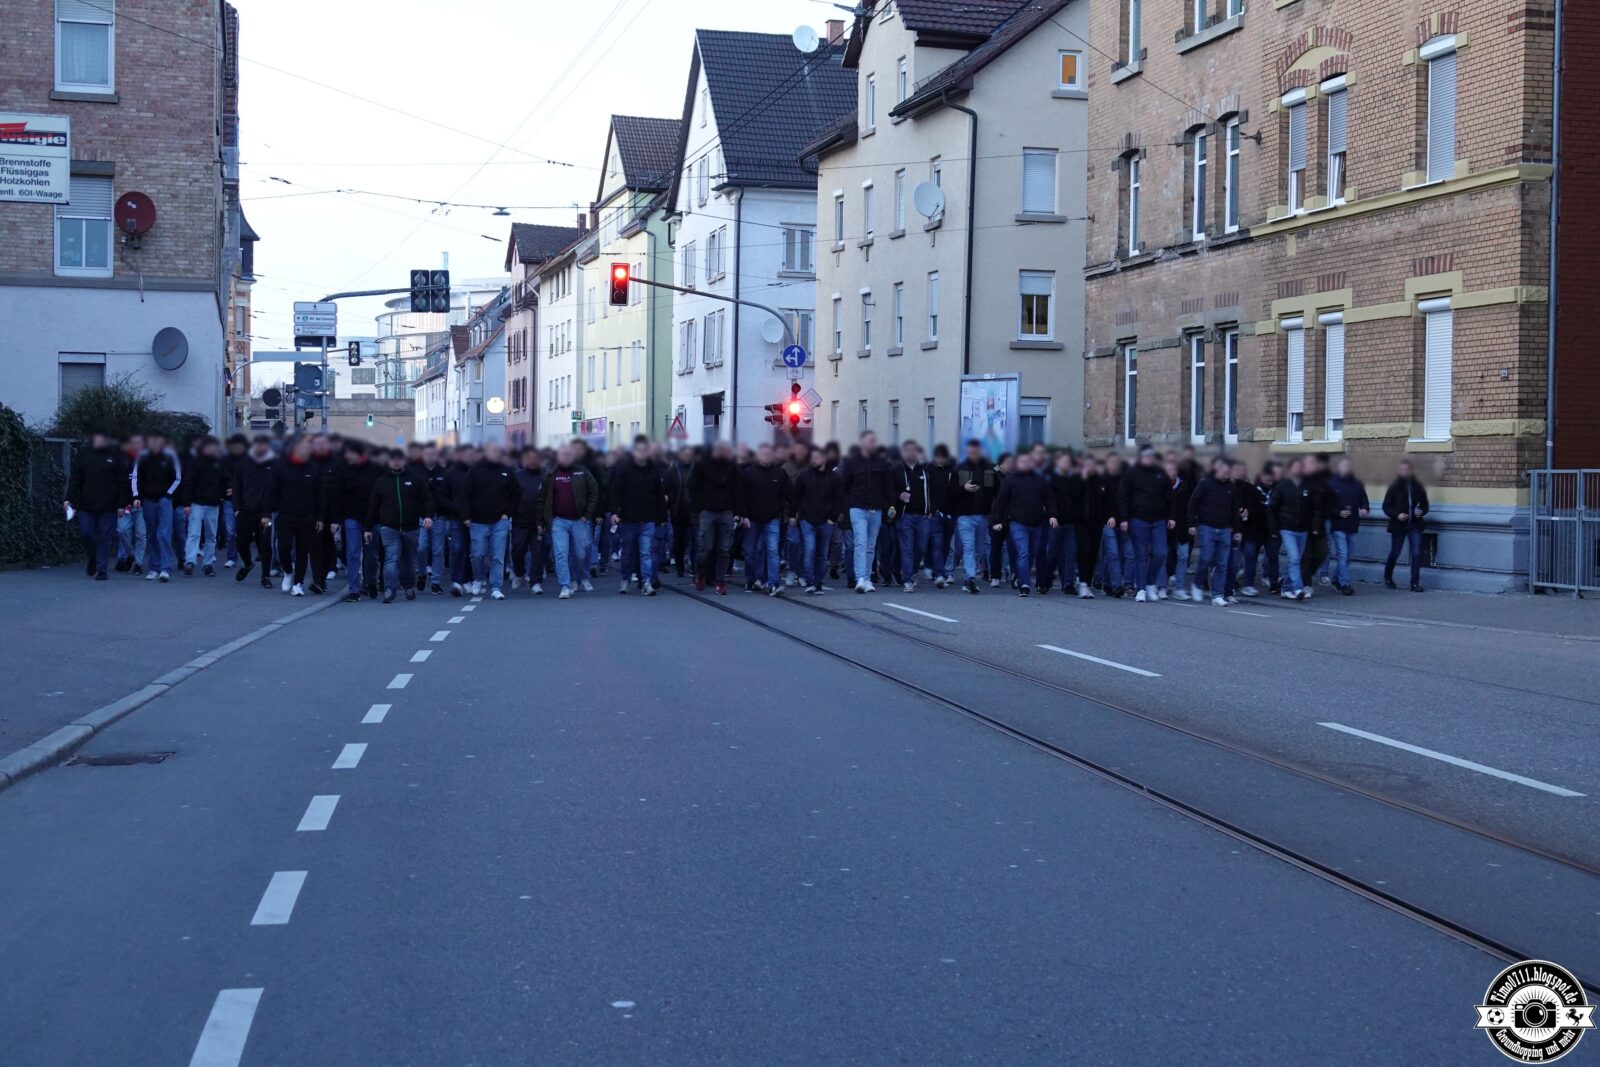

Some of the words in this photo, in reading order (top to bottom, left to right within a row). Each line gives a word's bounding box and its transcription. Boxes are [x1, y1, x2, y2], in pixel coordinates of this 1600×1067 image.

[0, 157, 51, 168] Brennstoffe
[1, 167, 49, 178] Flüssiggas
[0, 177, 50, 186] Holzkohlen
